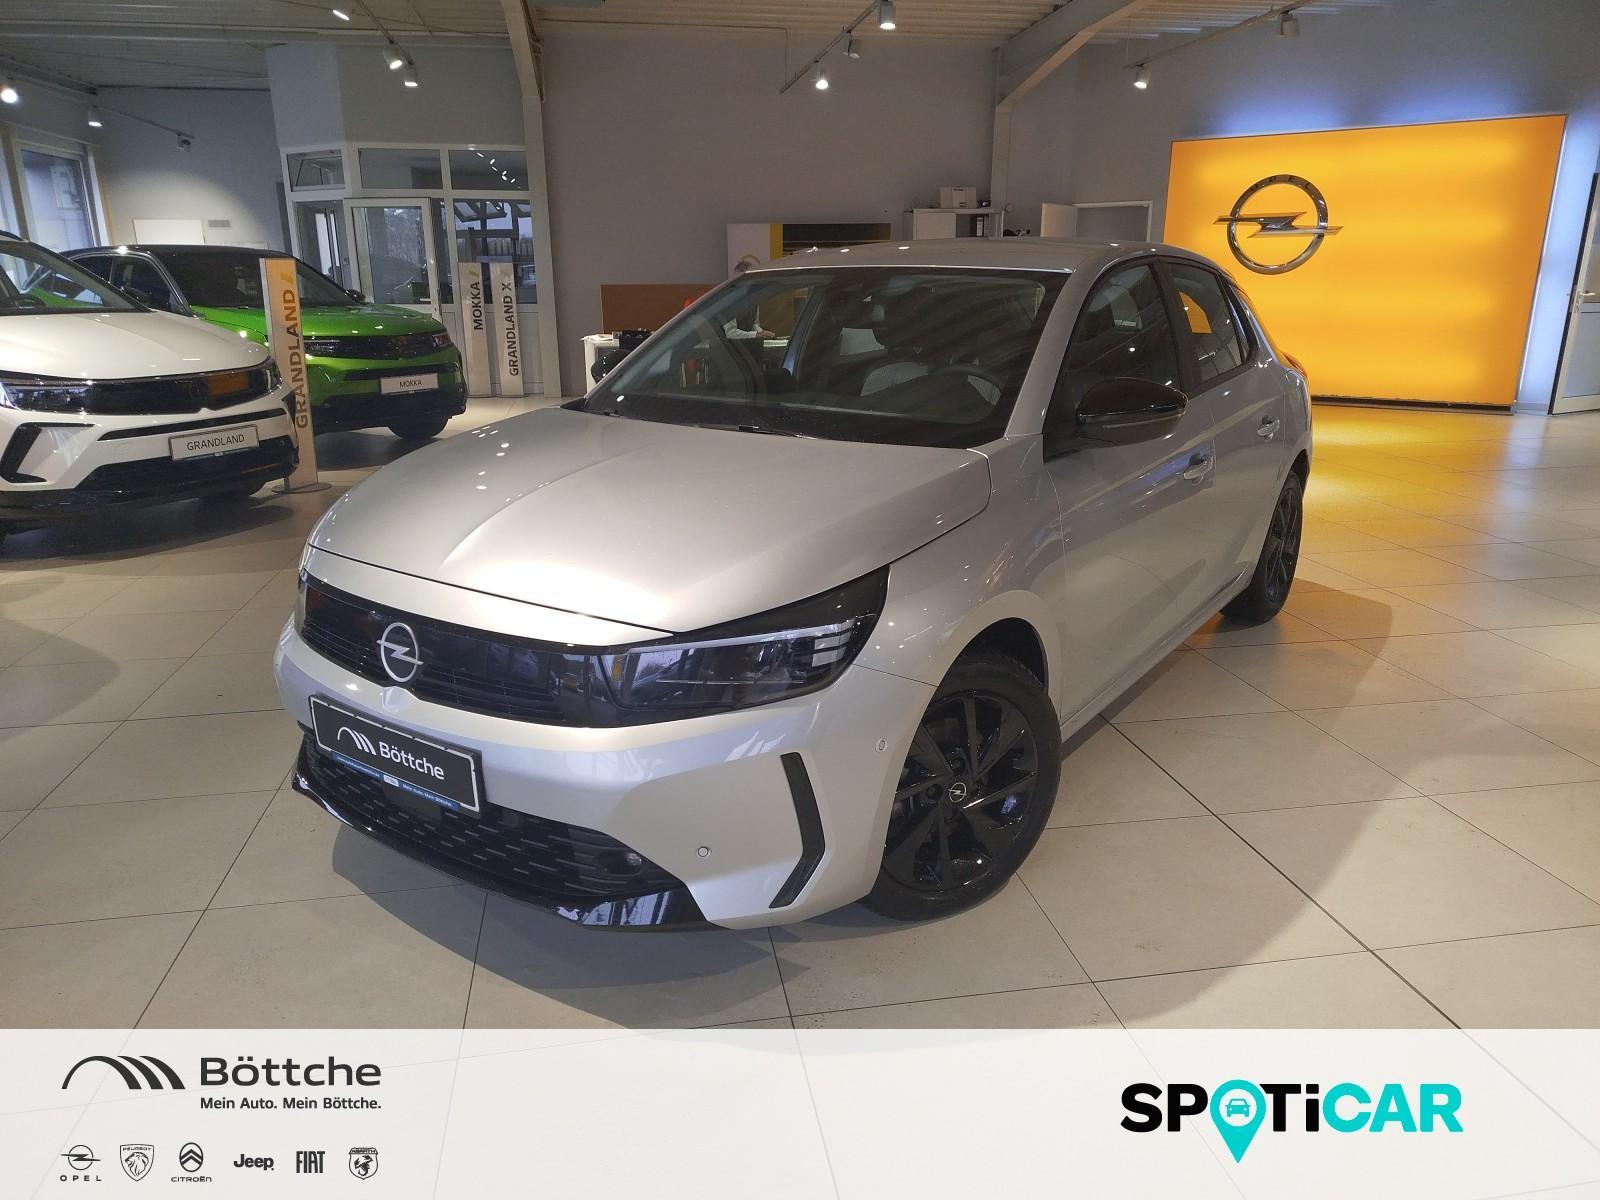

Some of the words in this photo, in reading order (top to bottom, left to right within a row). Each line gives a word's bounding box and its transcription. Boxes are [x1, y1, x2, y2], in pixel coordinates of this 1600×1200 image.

[470, 281, 483, 330] MOKKA
[502, 283, 511, 291] X
[503, 295, 519, 376] GRANDLAND
[282, 289, 308, 429] GRANDLAND
[400, 379, 422, 388] MOKKA
[186, 434, 245, 451] GRANDLAND
[379, 741, 445, 781] Böttche
